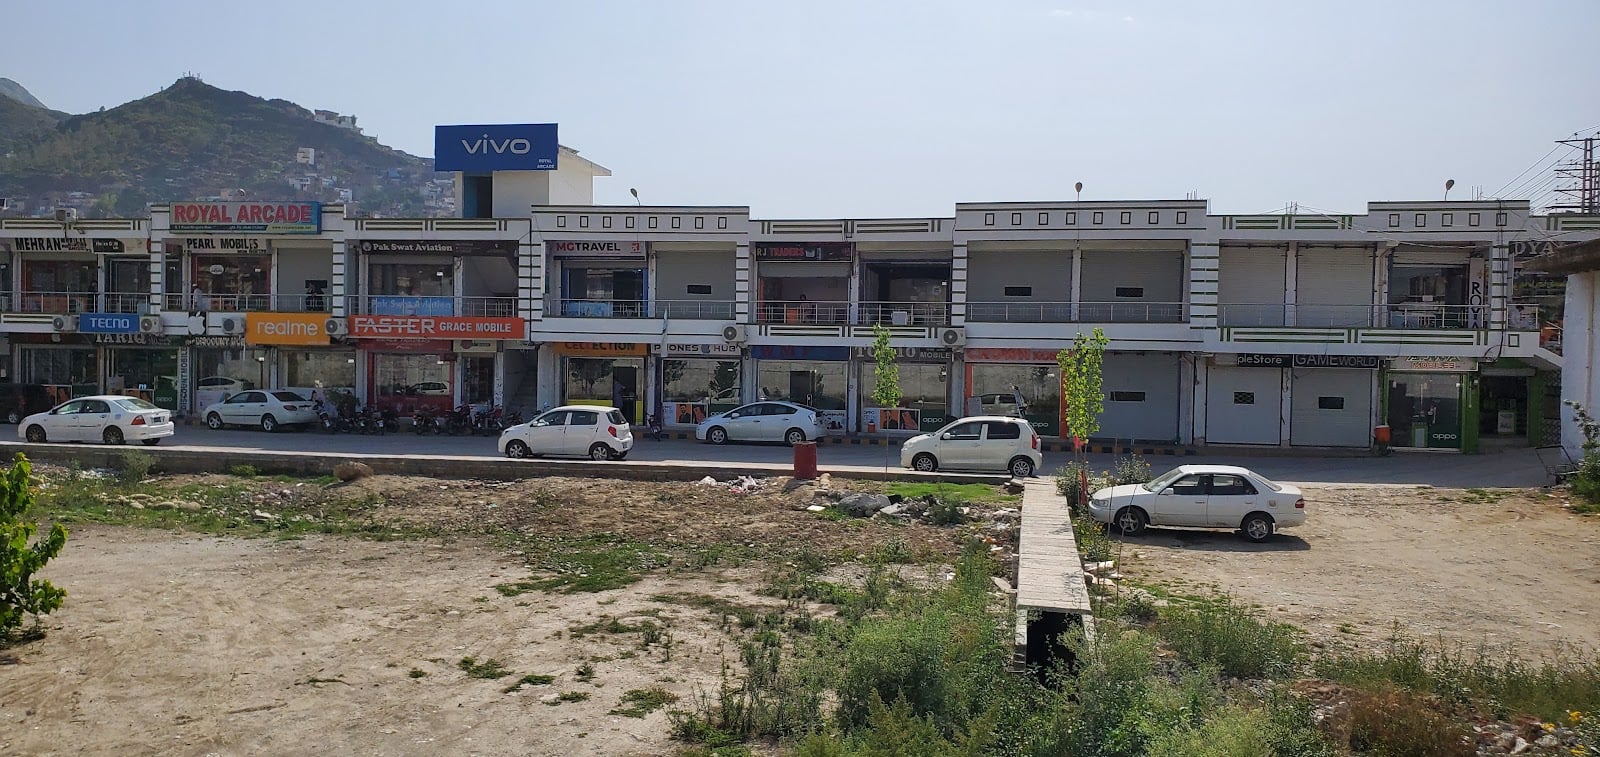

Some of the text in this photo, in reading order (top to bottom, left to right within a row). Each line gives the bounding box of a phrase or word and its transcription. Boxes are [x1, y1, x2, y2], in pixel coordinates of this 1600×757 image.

[461, 134, 531, 154] vivo
[174, 204, 312, 223] ROYAL ARCADE
[15, 237, 61, 251] MEHRAN
[186, 238, 216, 249] PEARL
[373, 243, 389, 251] Pak
[415, 244, 453, 252] Aviation
[757, 248, 767, 256] RJ
[89, 318, 129, 329] TECNO
[257, 320, 318, 336] realme
[354, 318, 511, 334] FASTER GRACE MOBILE
[654, 344, 699, 352] PONES
[920, 351, 952, 359] MOBILE
